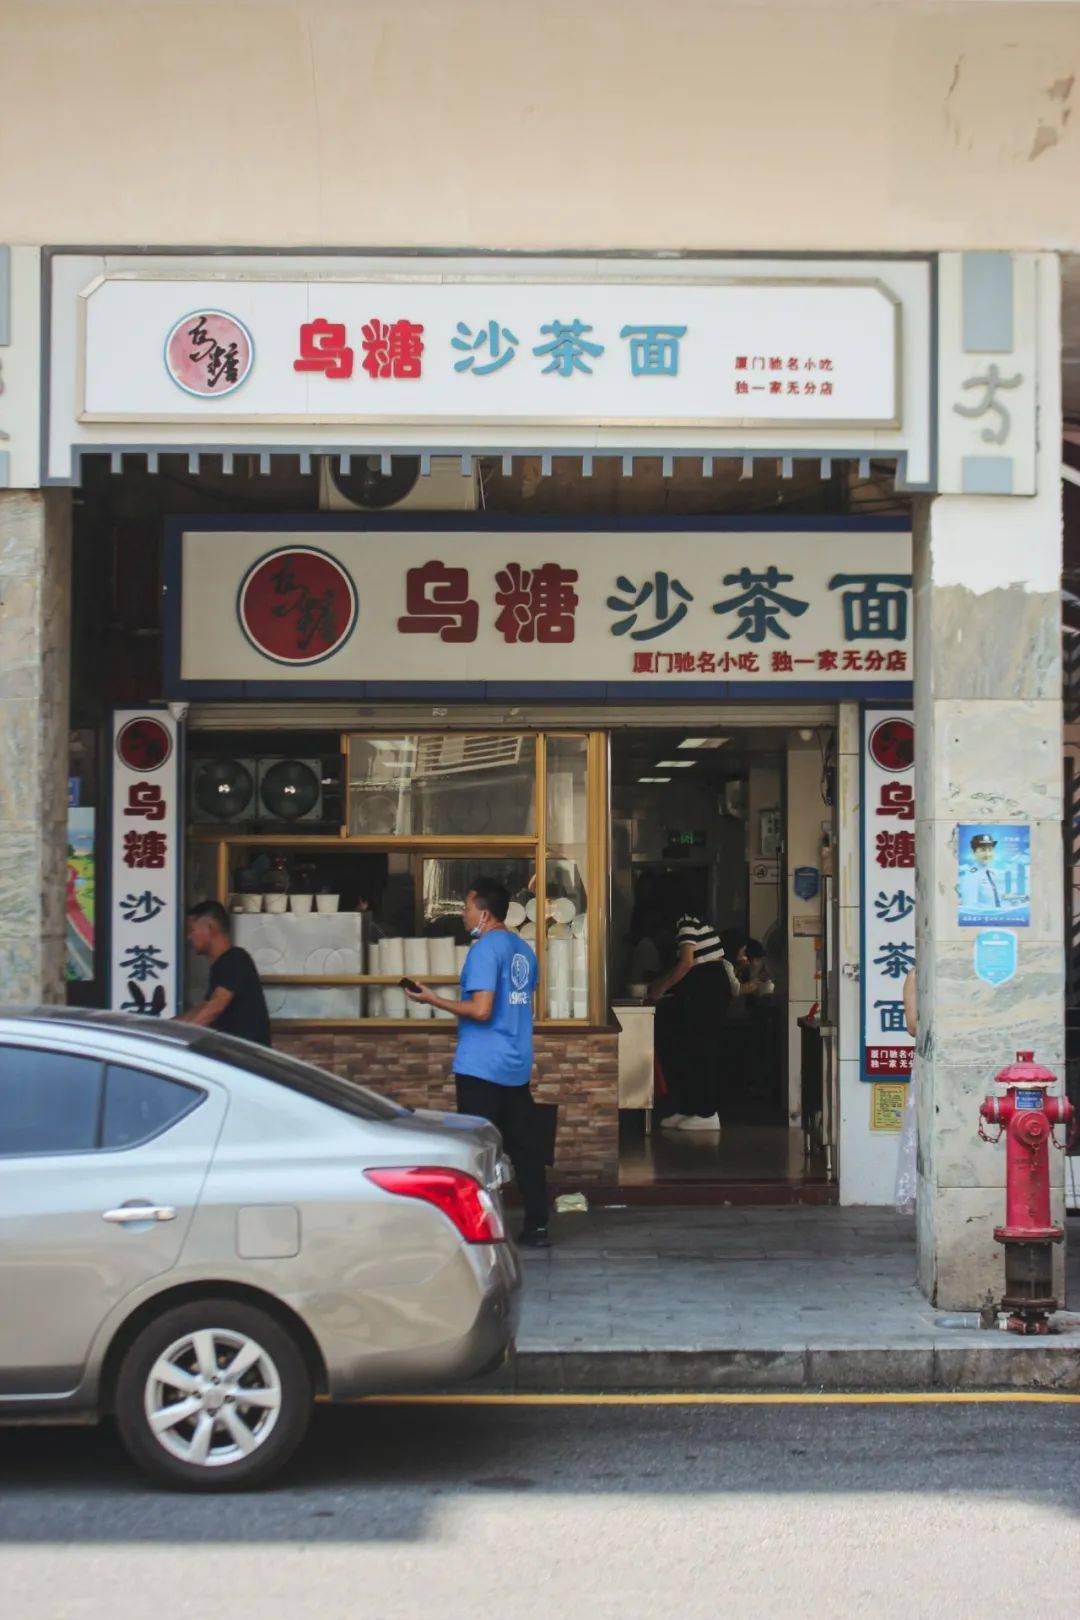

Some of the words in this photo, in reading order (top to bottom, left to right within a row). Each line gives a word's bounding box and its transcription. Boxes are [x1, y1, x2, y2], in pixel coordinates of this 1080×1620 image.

[293, 317, 688, 379] 乌糖沙茶面
[735, 356, 833, 371] 厦门驰名小吃
[735, 380, 833, 395] 独一家无分店
[397, 560, 913, 643] 乌糖沙茶面
[632, 650, 760, 673] 厦门驰名小吃
[771, 650, 907, 672] 独一家无分店
